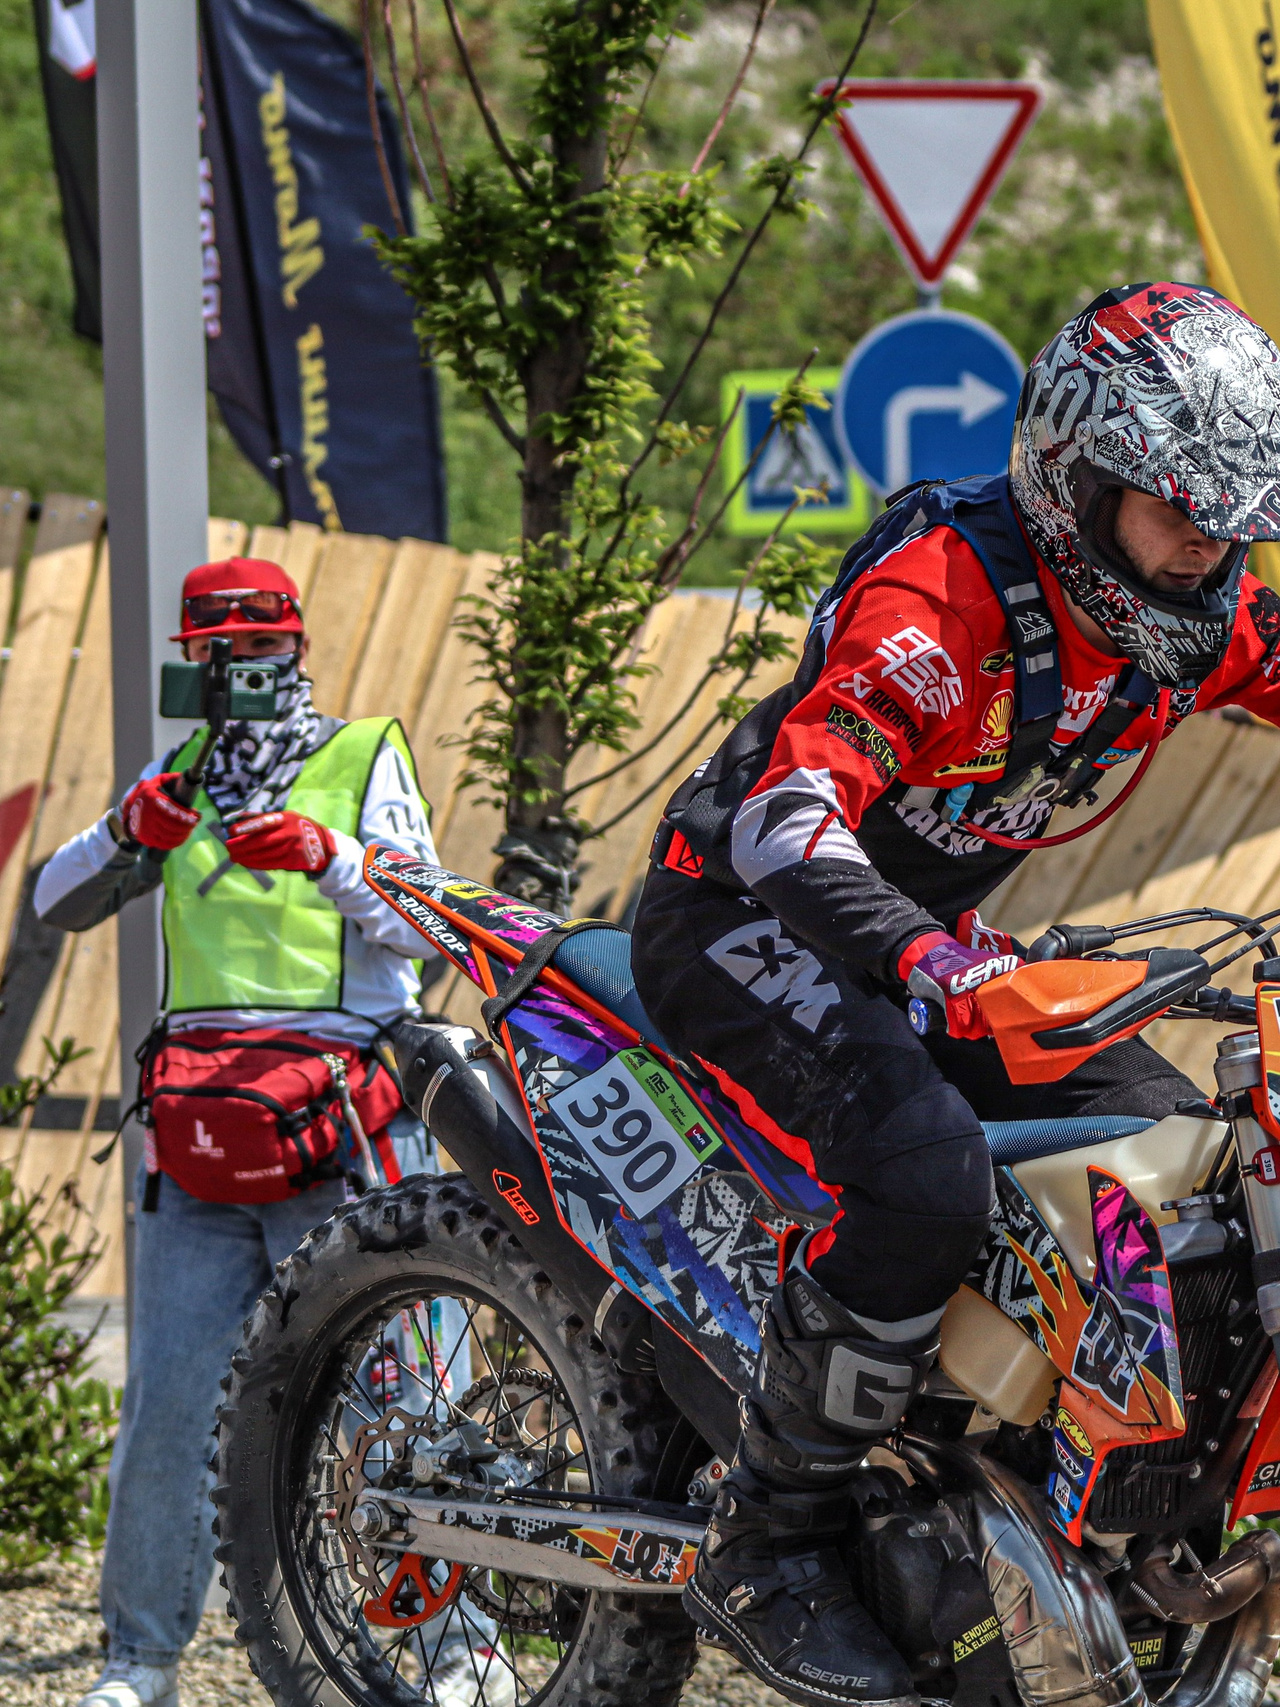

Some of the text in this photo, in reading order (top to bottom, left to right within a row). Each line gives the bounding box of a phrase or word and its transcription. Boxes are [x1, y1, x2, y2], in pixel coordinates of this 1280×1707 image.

[398, 894, 469, 954] DUNLOP
[568, 1077, 677, 1193] 390
[1264, 1159, 1273, 1173] 390
[962, 1615, 1000, 1644] ENDURO
